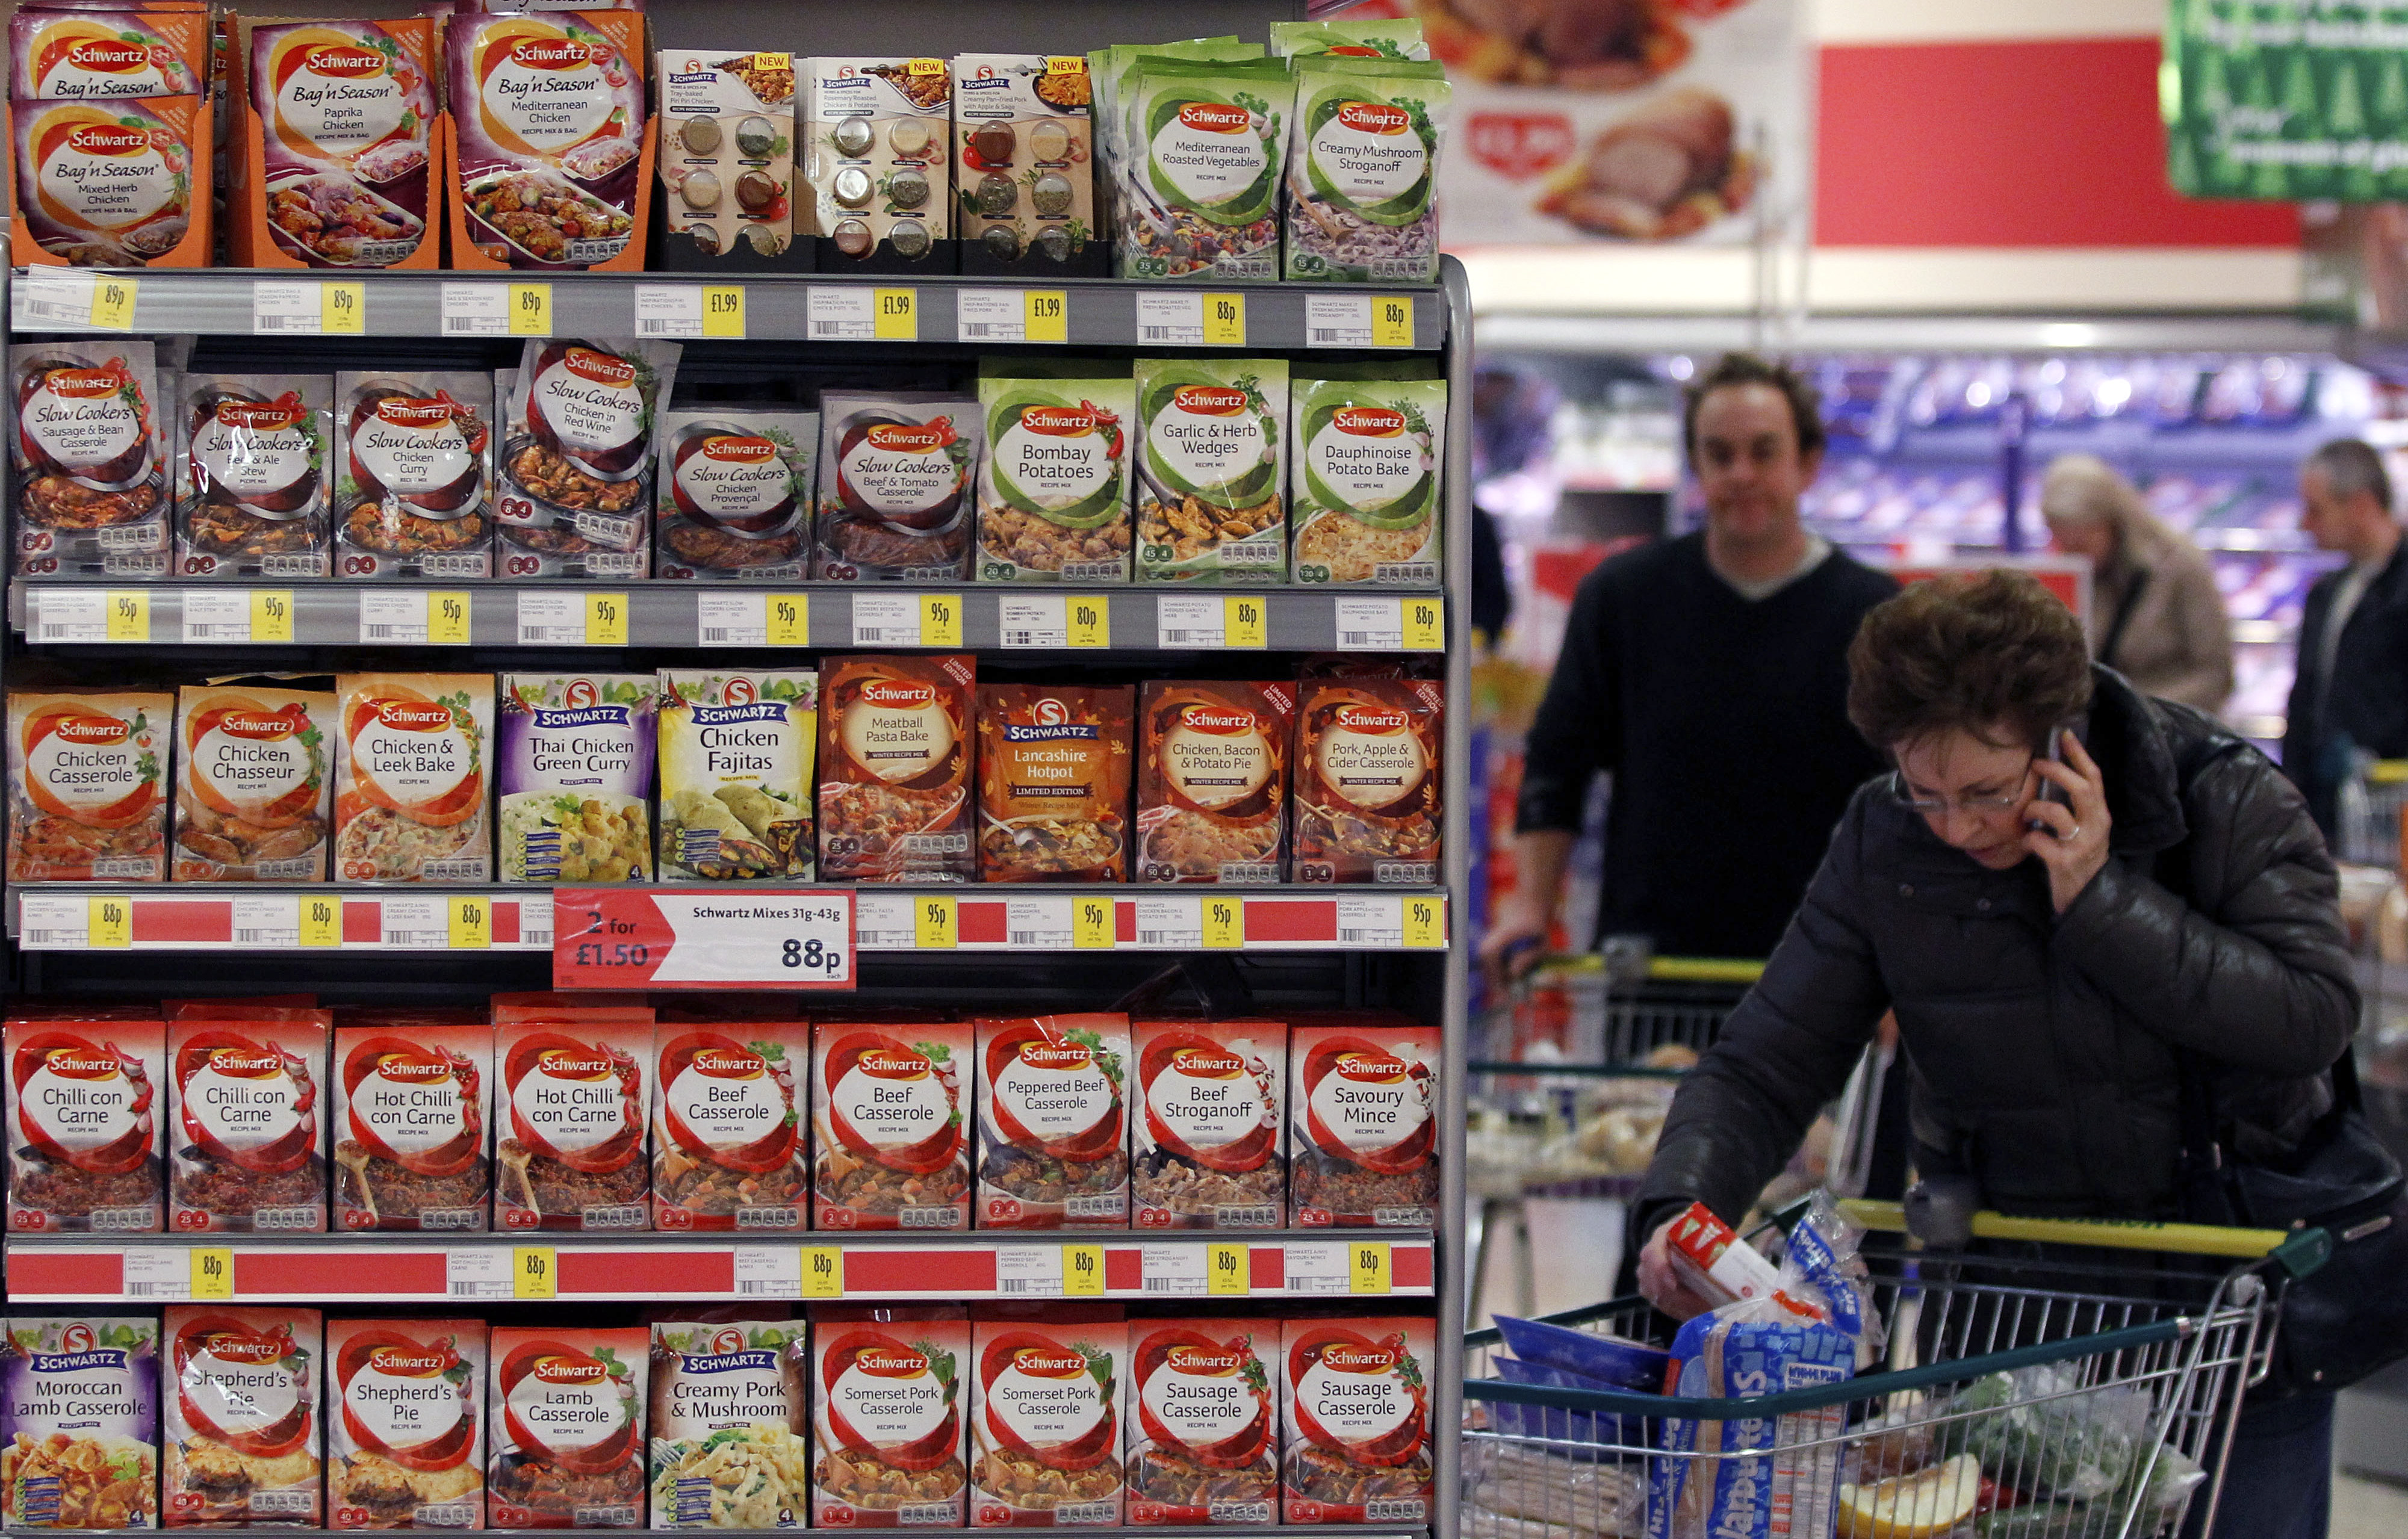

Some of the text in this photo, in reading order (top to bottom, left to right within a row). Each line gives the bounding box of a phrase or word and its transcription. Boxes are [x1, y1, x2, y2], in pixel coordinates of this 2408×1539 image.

[309, 53, 380, 69] Schwartz
[759, 56, 786, 67] NEW
[913, 62, 939, 72] NEW
[964, 80, 1006, 89] SCHWARTZ
[510, 99, 588, 111] Mediterranean
[529, 113, 571, 123] Chicken
[1339, 107, 1405, 126] Schwartz
[1175, 142, 1251, 155] Mediterranean
[1318, 141, 1424, 159] Creamy Mushroom
[1162, 154, 1261, 168] Roasted Vegetables
[1338, 158, 1401, 173] Stroganoff
[78, 182, 138, 194] Mixed Herb
[87, 193, 130, 205] Chicken
[1138, 261, 1151, 272] 35
[105, 285, 124, 310] 89p
[522, 291, 541, 316] 89p
[711, 294, 737, 312] £1.99
[1386, 303, 1404, 328] 88p
[380, 406, 445, 420] Schwartz
[563, 403, 616, 422] Chicken in
[563, 415, 611, 433] Red Wine
[1336, 413, 1400, 428] Schwartz
[42, 425, 123, 438] Sausage & Bean
[872, 431, 935, 445] Schwartz
[1164, 424, 1257, 438] Garlic & Herb
[60, 436, 108, 447] Casserole
[1182, 441, 1239, 456] Wedges
[1022, 445, 1091, 463] Bombay
[1325, 445, 1412, 462] Dauphinoise
[854, 459, 951, 475] Slow Cookers
[1018, 462, 1094, 478] Potatoes
[1326, 462, 1409, 475] Potato Bake
[716, 483, 757, 494] Chicken
[863, 476, 939, 488] Beef & Tomato
[710, 492, 761, 504] Provençal
[877, 486, 925, 497] Casserole
[265, 597, 284, 621] 95p
[931, 602, 949, 627] 95p
[1238, 604, 1257, 628] 88p
[382, 708, 446, 723] Schwartz
[700, 707, 777, 722] SCHWARTZ
[1339, 712, 1401, 726] Schwartz
[872, 717, 923, 728] Meatball
[700, 728, 778, 748] Chicken
[866, 730, 929, 742] Pasta Bake
[1010, 726, 1089, 740] SCHWARTZ
[371, 739, 453, 754] Chicken &
[529, 738, 634, 754] Thai Chicken
[1172, 745, 1261, 757] Chicken, Bacon
[1332, 743, 1409, 758] Pork, Apple &
[218, 746, 290, 763] Chicken
[708, 751, 773, 772] Fajitas
[1014, 748, 1087, 763] Lancashire
[212, 762, 295, 779] Chasseur
[373, 756, 455, 772] Leek Bake
[533, 755, 631, 772] Green Curry
[1181, 758, 1252, 769] & Potato Pie
[1327, 757, 1415, 769] Cider Casserole
[1027, 766, 1073, 781] Hotpot
[104, 903, 122, 928] 88p
[693, 907, 841, 922] Schwartz Mixes 31g-43g
[1085, 904, 1103, 929] 95p
[1413, 903, 1431, 927] 95p
[588, 911, 636, 934] 2 for
[576, 943, 648, 967] £1.50
[781, 938, 841, 974] 88p
[862, 1057, 926, 1071] Schwartz
[1339, 1059, 1403, 1075] Schwartz
[1007, 1079, 1105, 1096] Peppered Beef
[1190, 1086, 1229, 1102] Beef
[43, 1089, 122, 1105] Chilli con
[536, 1088, 613, 1104] Hot Chilli
[1025, 1096, 1088, 1110] Casserole
[1334, 1088, 1404, 1107] Savoury
[57, 1107, 108, 1124] Carne
[532, 1106, 616, 1123] con Carne
[1165, 1102, 1252, 1121] Stroganoff
[1344, 1107, 1397, 1123] Mince
[813, 1254, 832, 1278] 88p
[1218, 1251, 1237, 1276] 88p
[39, 1353, 116, 1370] SCHWARTZ
[689, 1354, 766, 1370] SCHWARTZ
[1171, 1353, 1235, 1367] Schwartz
[537, 1363, 601, 1377] Schwartz
[36, 1381, 123, 1396] Moroccan
[357, 1384, 452, 1404] Shepherd's
[674, 1381, 786, 1401] Creamy Pork
[845, 1386, 939, 1400] Somerset Pork
[1321, 1380, 1392, 1399] Sausage
[11, 1399, 147, 1417] Lamb Casserole
[393, 1405, 420, 1420] Pie
[671, 1402, 787, 1417] & Mushroom
[860, 1402, 923, 1415] Casserole
[1317, 1400, 1396, 1415] Casserole
[782, 1509, 792, 1520] 4
